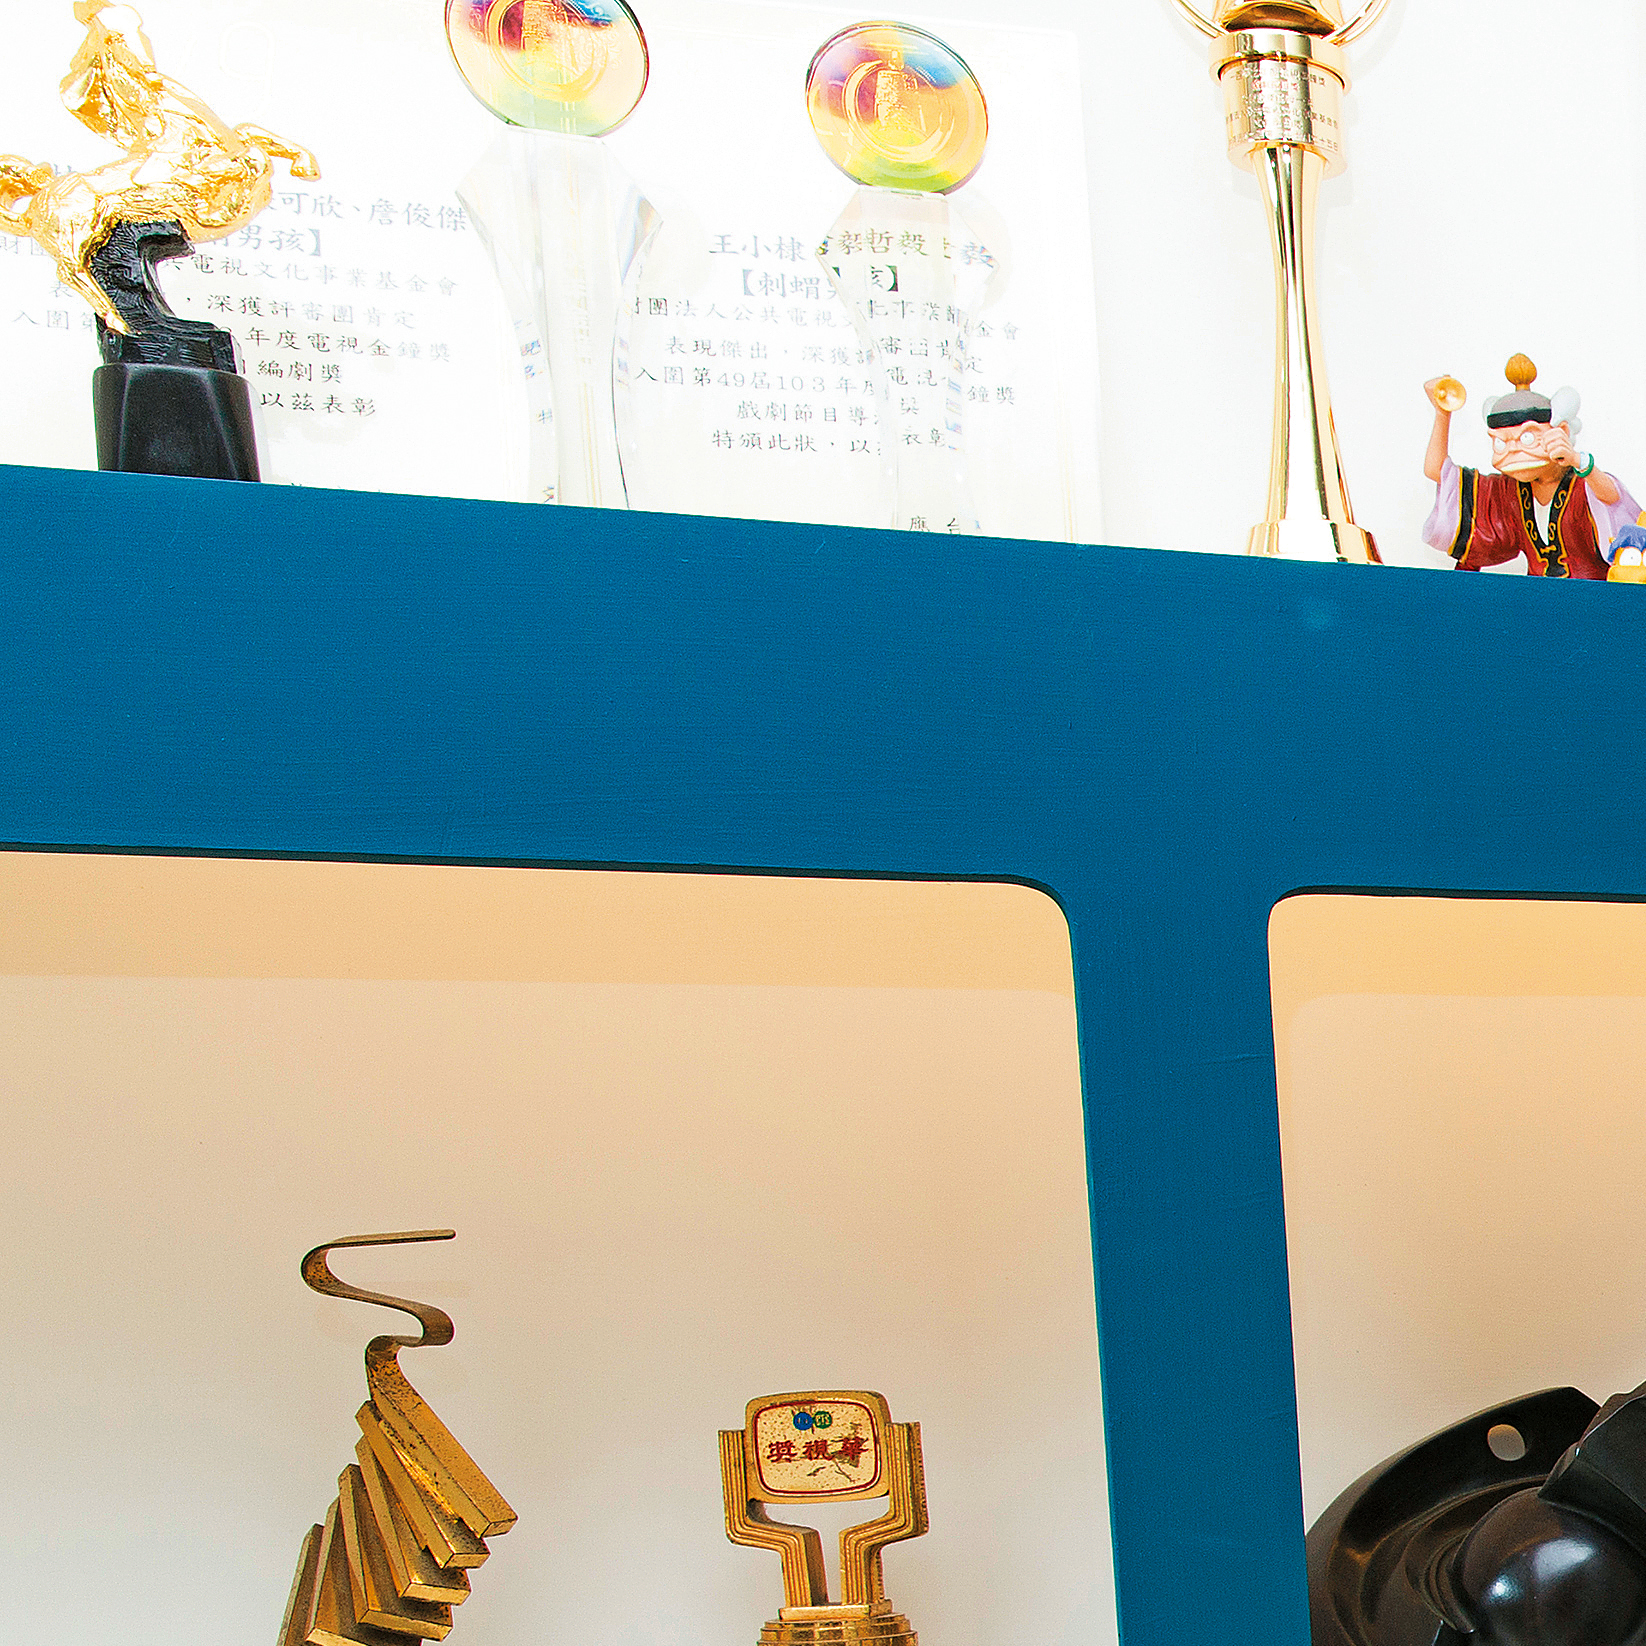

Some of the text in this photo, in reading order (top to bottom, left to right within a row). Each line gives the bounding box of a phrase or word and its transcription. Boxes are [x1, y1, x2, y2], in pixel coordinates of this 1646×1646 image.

[266, 191, 468, 232] 可欣、詹俊傑
